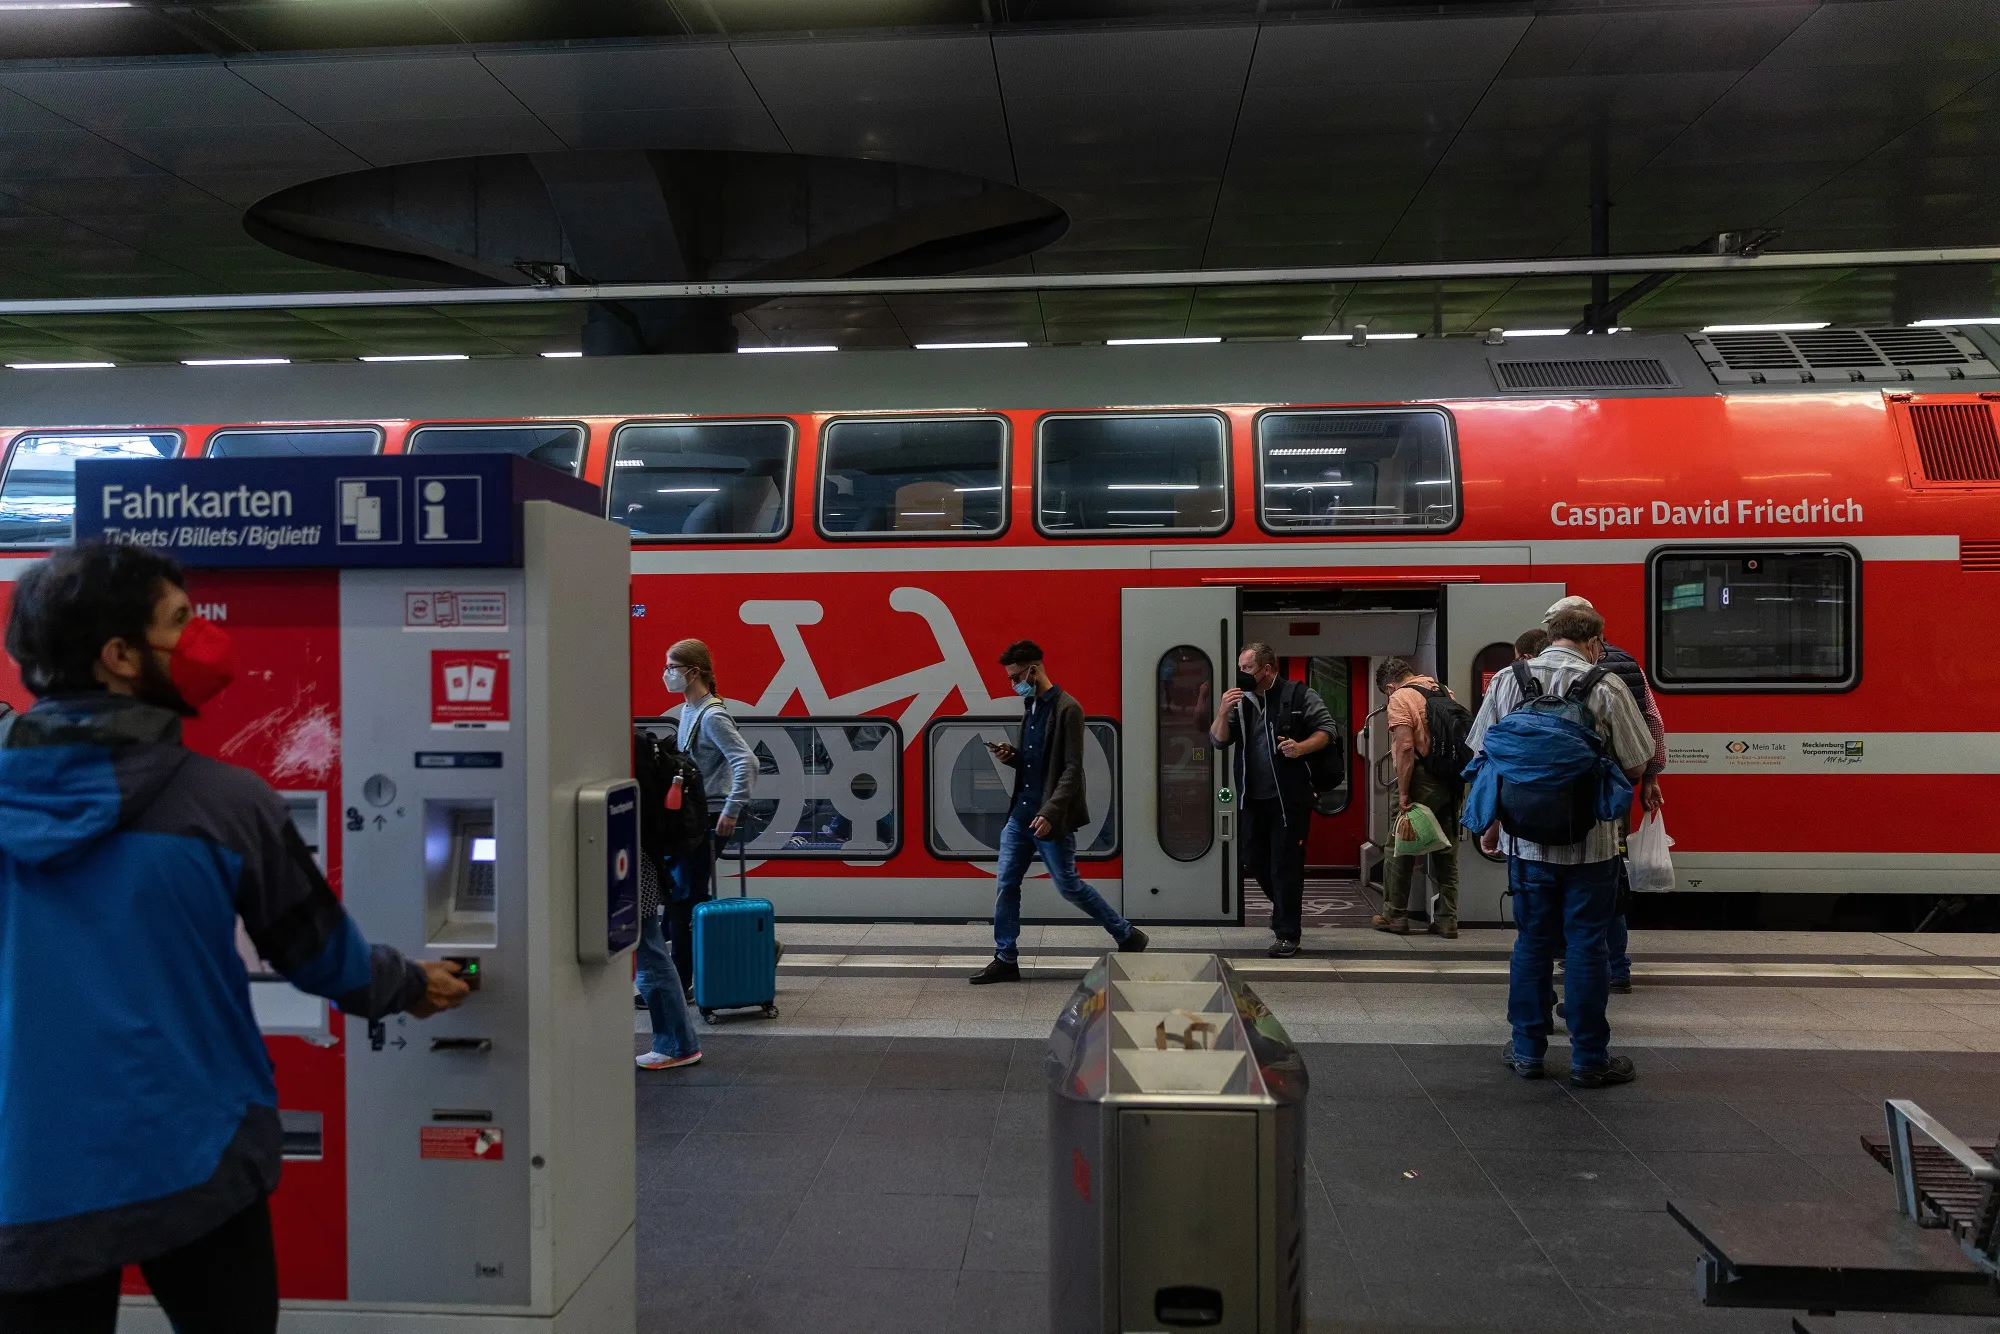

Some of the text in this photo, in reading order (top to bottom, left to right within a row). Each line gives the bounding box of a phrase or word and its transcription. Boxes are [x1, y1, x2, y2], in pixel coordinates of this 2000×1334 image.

[103, 484, 292, 519] Fahrkarten
[1550, 498, 1863, 531] Caspar David Friedrich
[1752, 743, 1786, 751] Mein Takt
